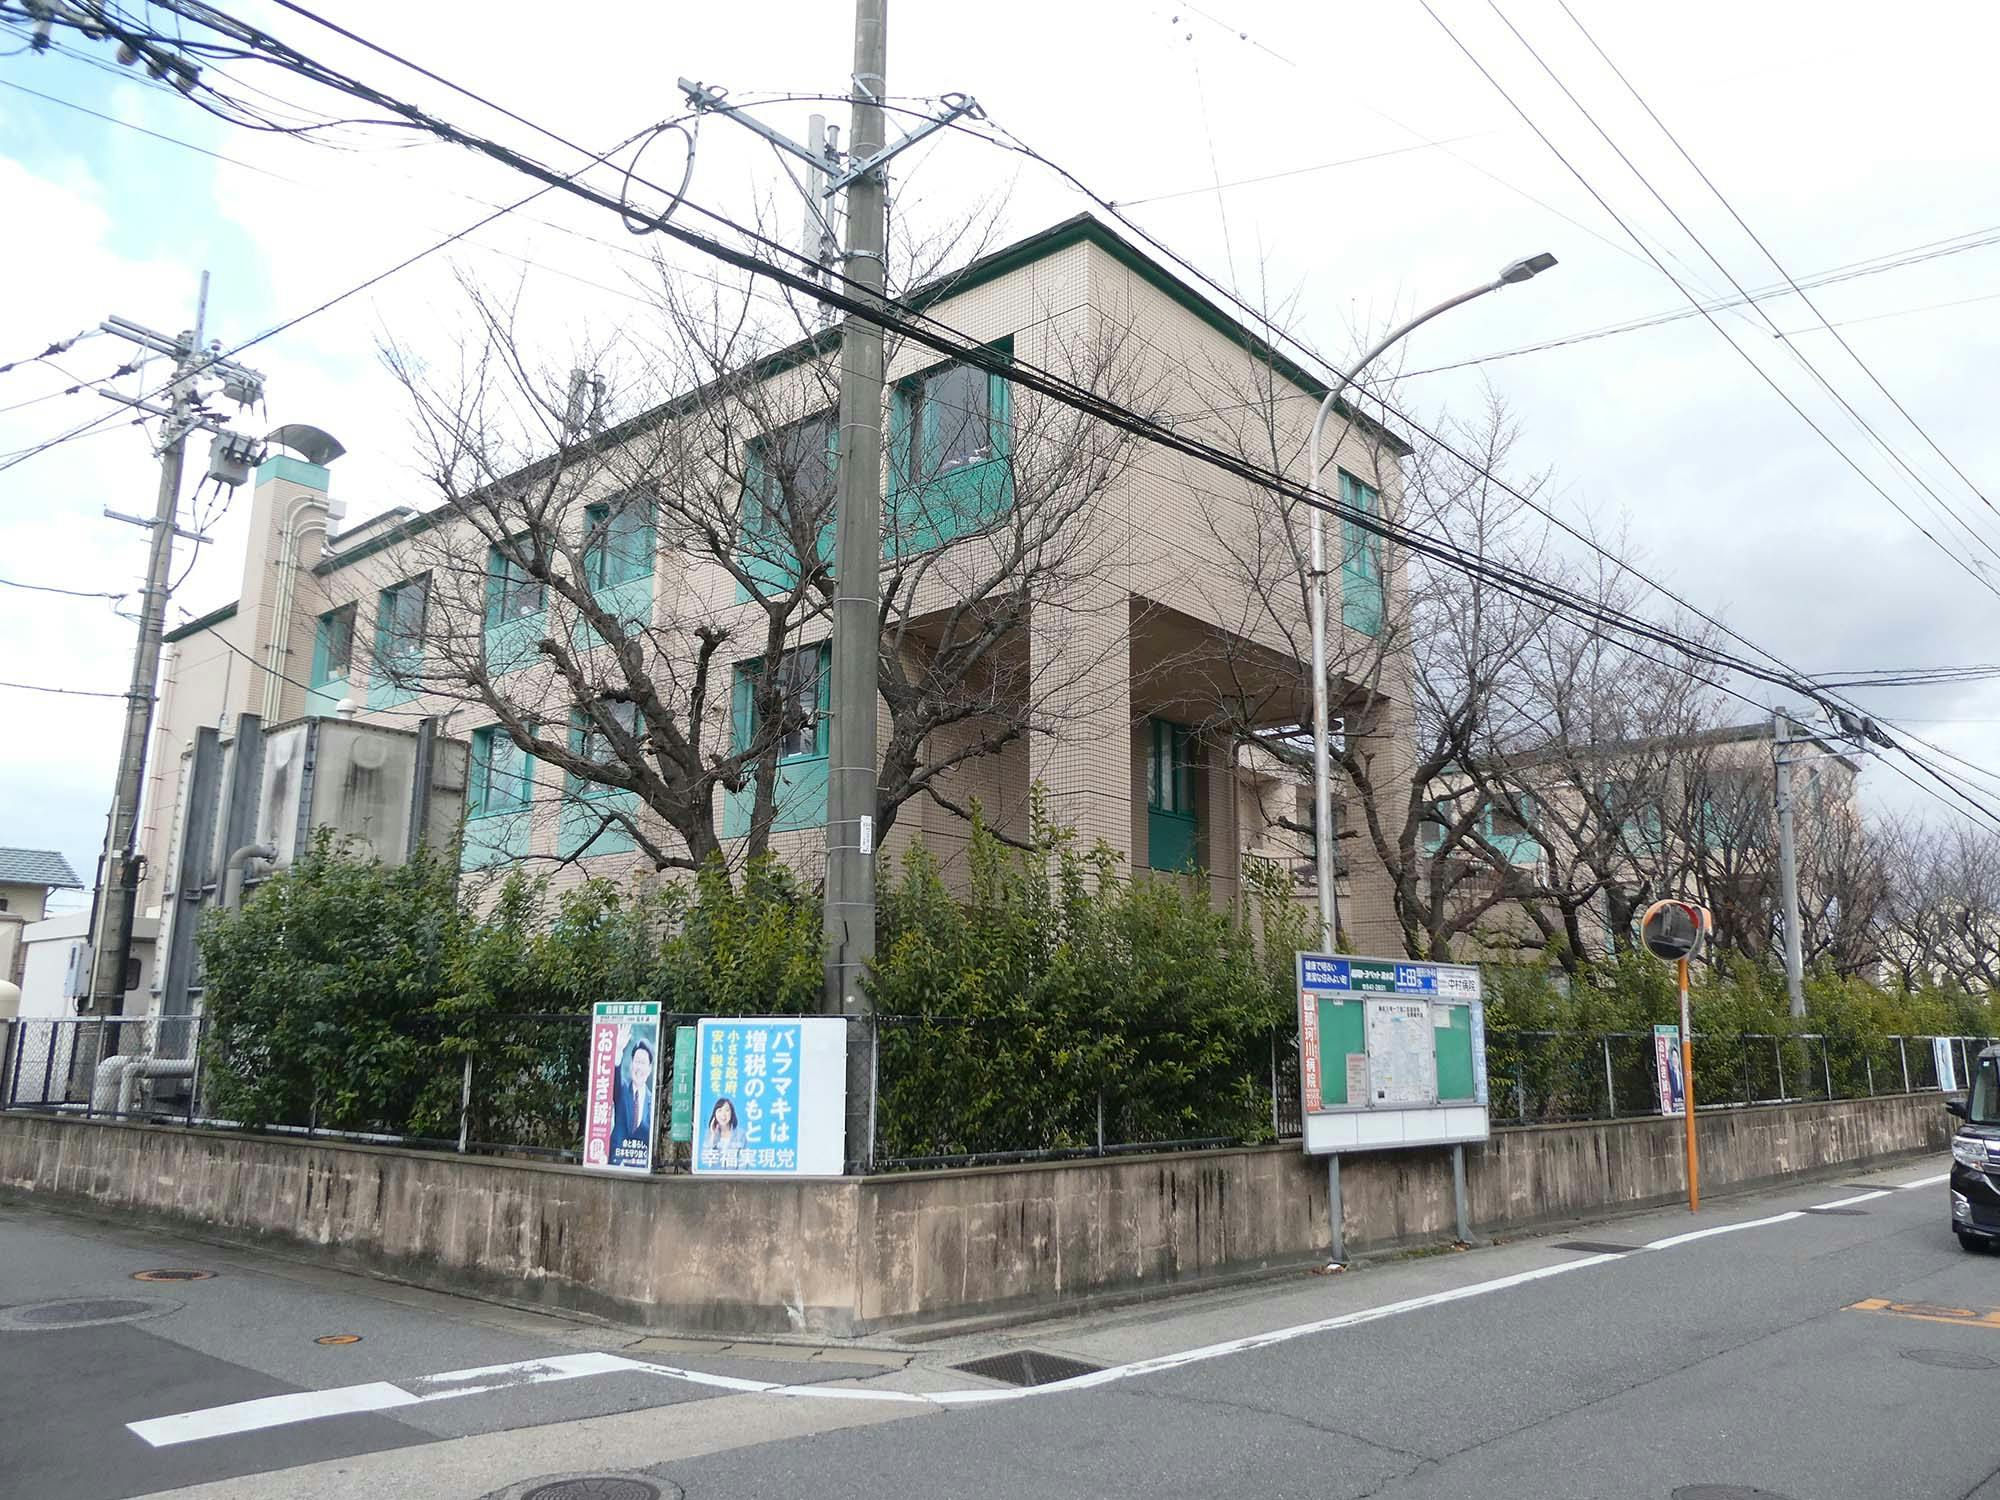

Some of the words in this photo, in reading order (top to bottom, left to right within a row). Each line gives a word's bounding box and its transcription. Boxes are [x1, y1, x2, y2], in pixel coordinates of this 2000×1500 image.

[1397, 967, 1416, 987] 上田
[1448, 979, 1476, 992] 中村病院
[744, 1030, 768, 1143] 増税のもと
[769, 1029, 796, 1143] バラマキは
[701, 1147, 795, 1169] 幸福実現党
